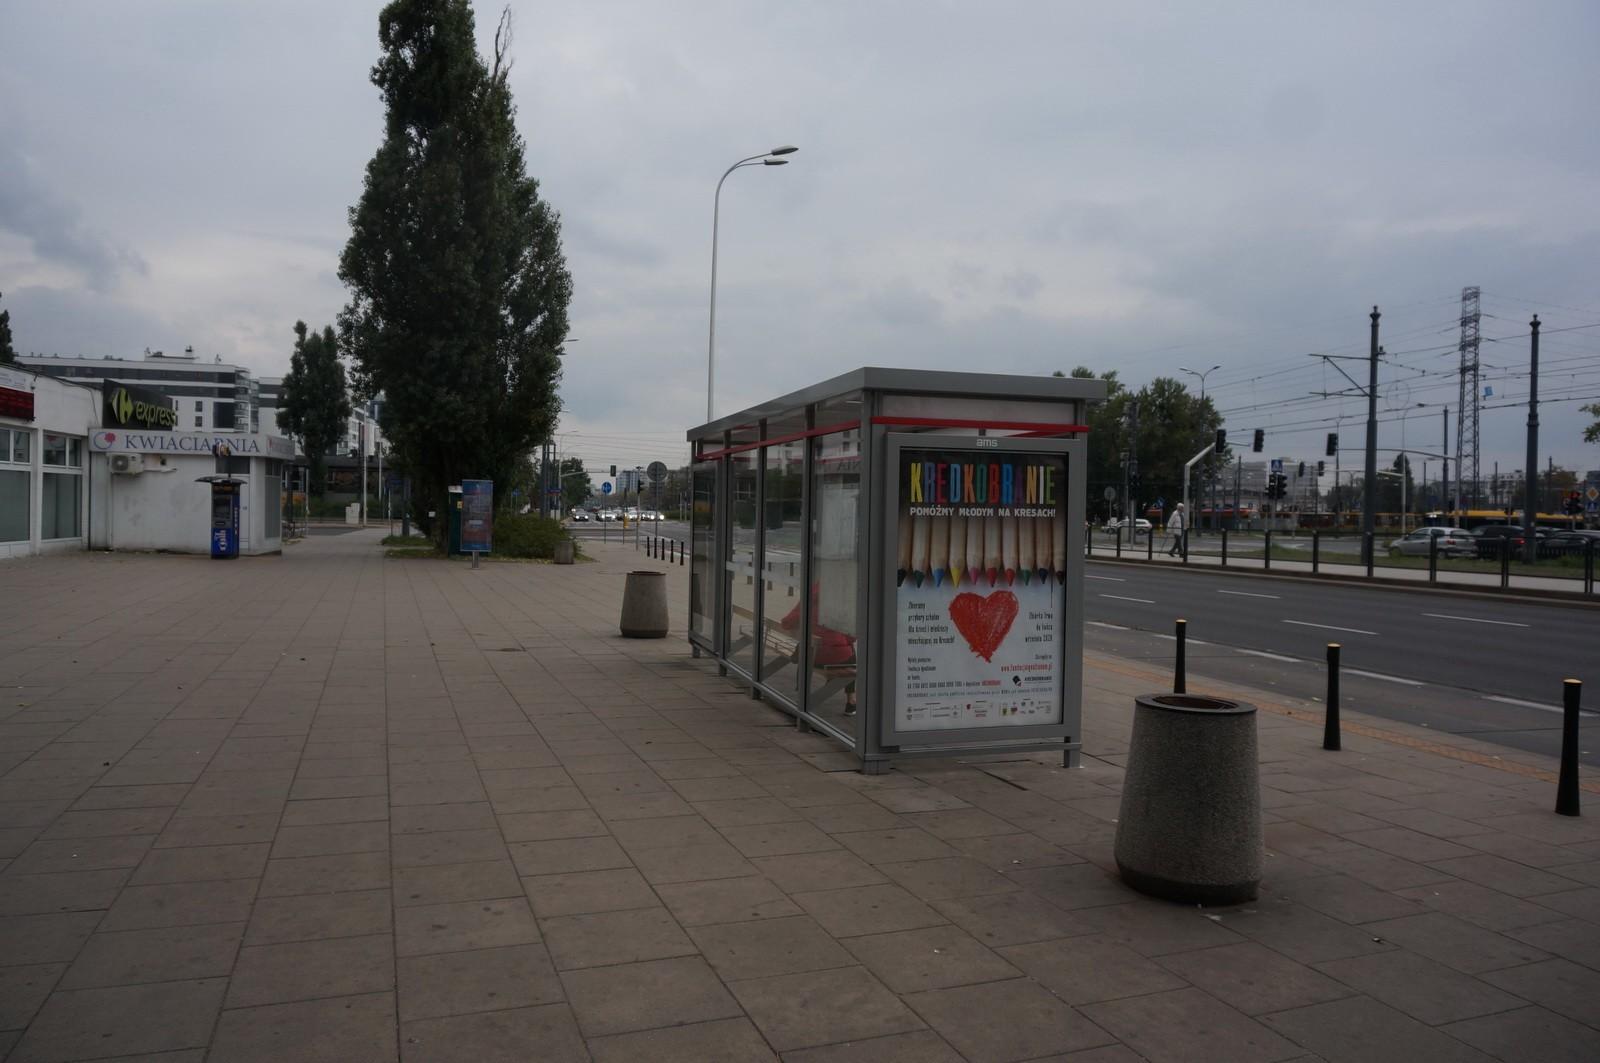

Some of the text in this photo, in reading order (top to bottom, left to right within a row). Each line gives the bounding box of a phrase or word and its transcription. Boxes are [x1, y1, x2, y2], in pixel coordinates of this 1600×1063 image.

[136, 400, 176, 428] express
[976, 438, 998, 447] ams
[910, 462, 1056, 504] KREDKOBRANIE
[910, 504, 1056, 518] POMÓŻMY MŁODYM NA KRESACH!
